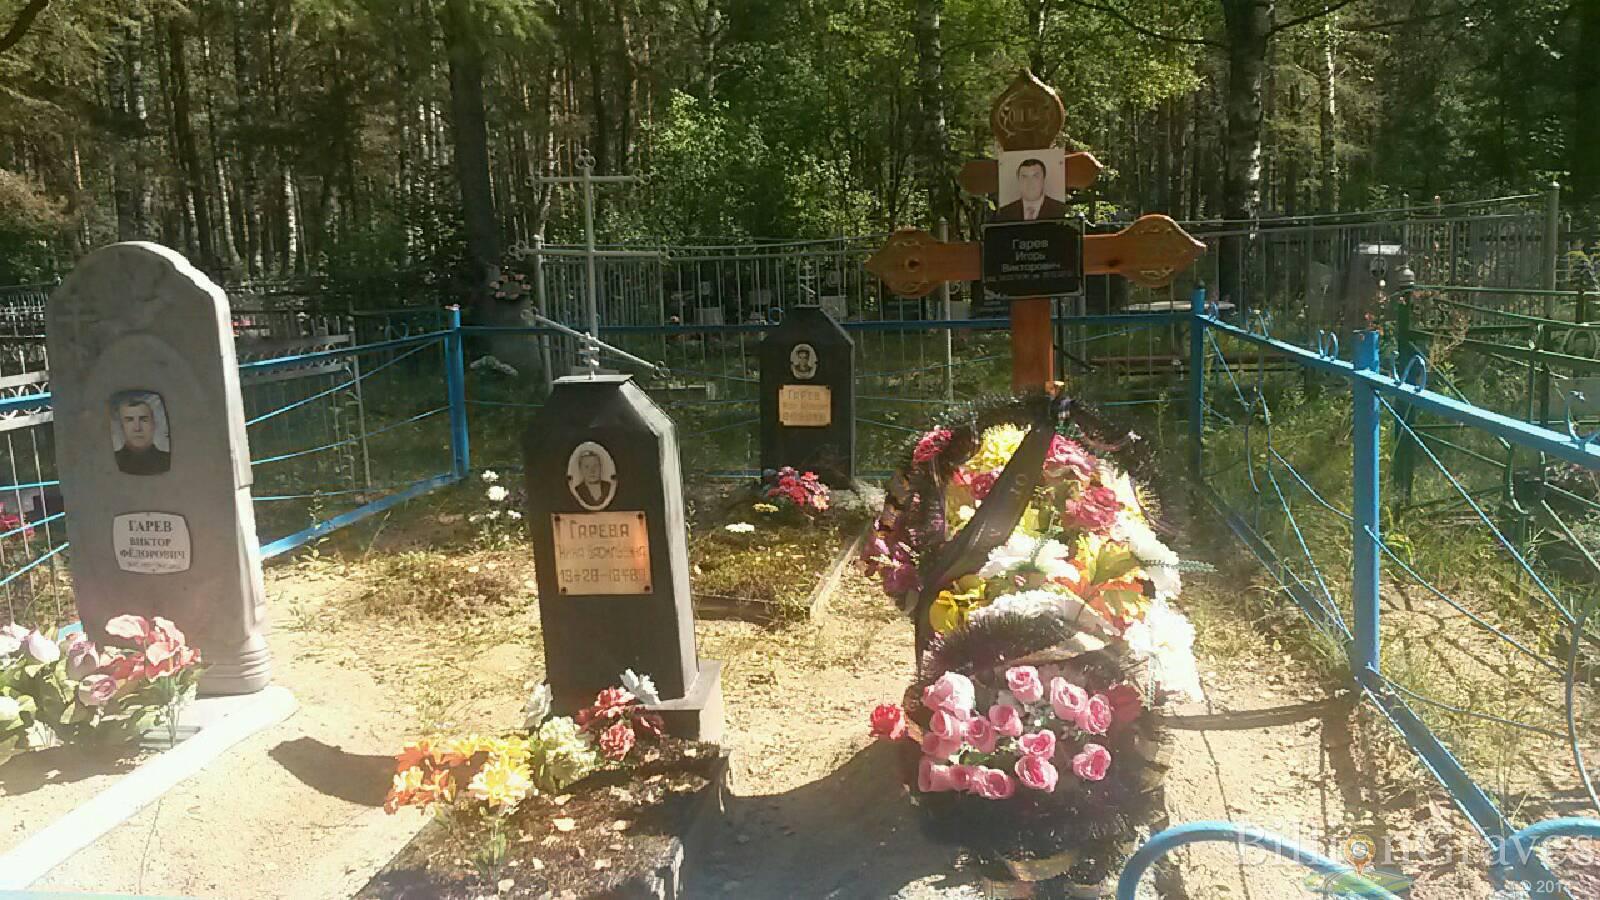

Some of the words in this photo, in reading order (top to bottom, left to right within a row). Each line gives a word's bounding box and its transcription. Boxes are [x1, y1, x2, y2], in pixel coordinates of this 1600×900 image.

[1012, 239, 1049, 250] Гарев
[128, 520, 173, 532] ГАРЕВ
[129, 536, 172, 547] ВИКТОР
